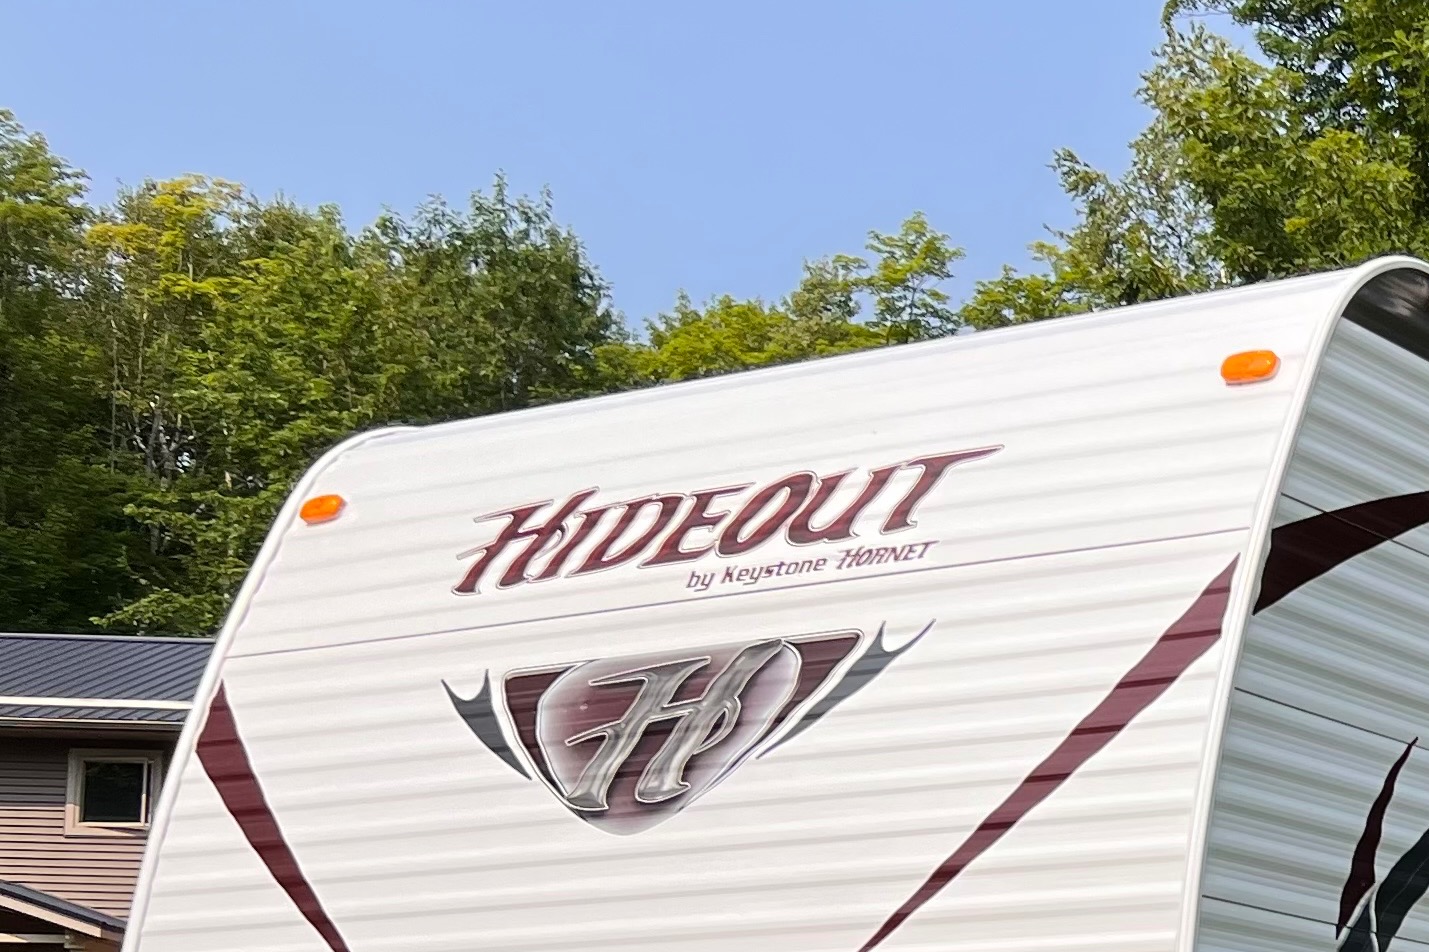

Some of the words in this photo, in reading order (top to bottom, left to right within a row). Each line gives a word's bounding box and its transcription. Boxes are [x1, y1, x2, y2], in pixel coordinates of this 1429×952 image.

[451, 444, 1005, 595] HIDEOUT
[685, 570, 716, 593] by
[720, 557, 828, 587] Keystone
[835, 540, 940, 571] HORNET
